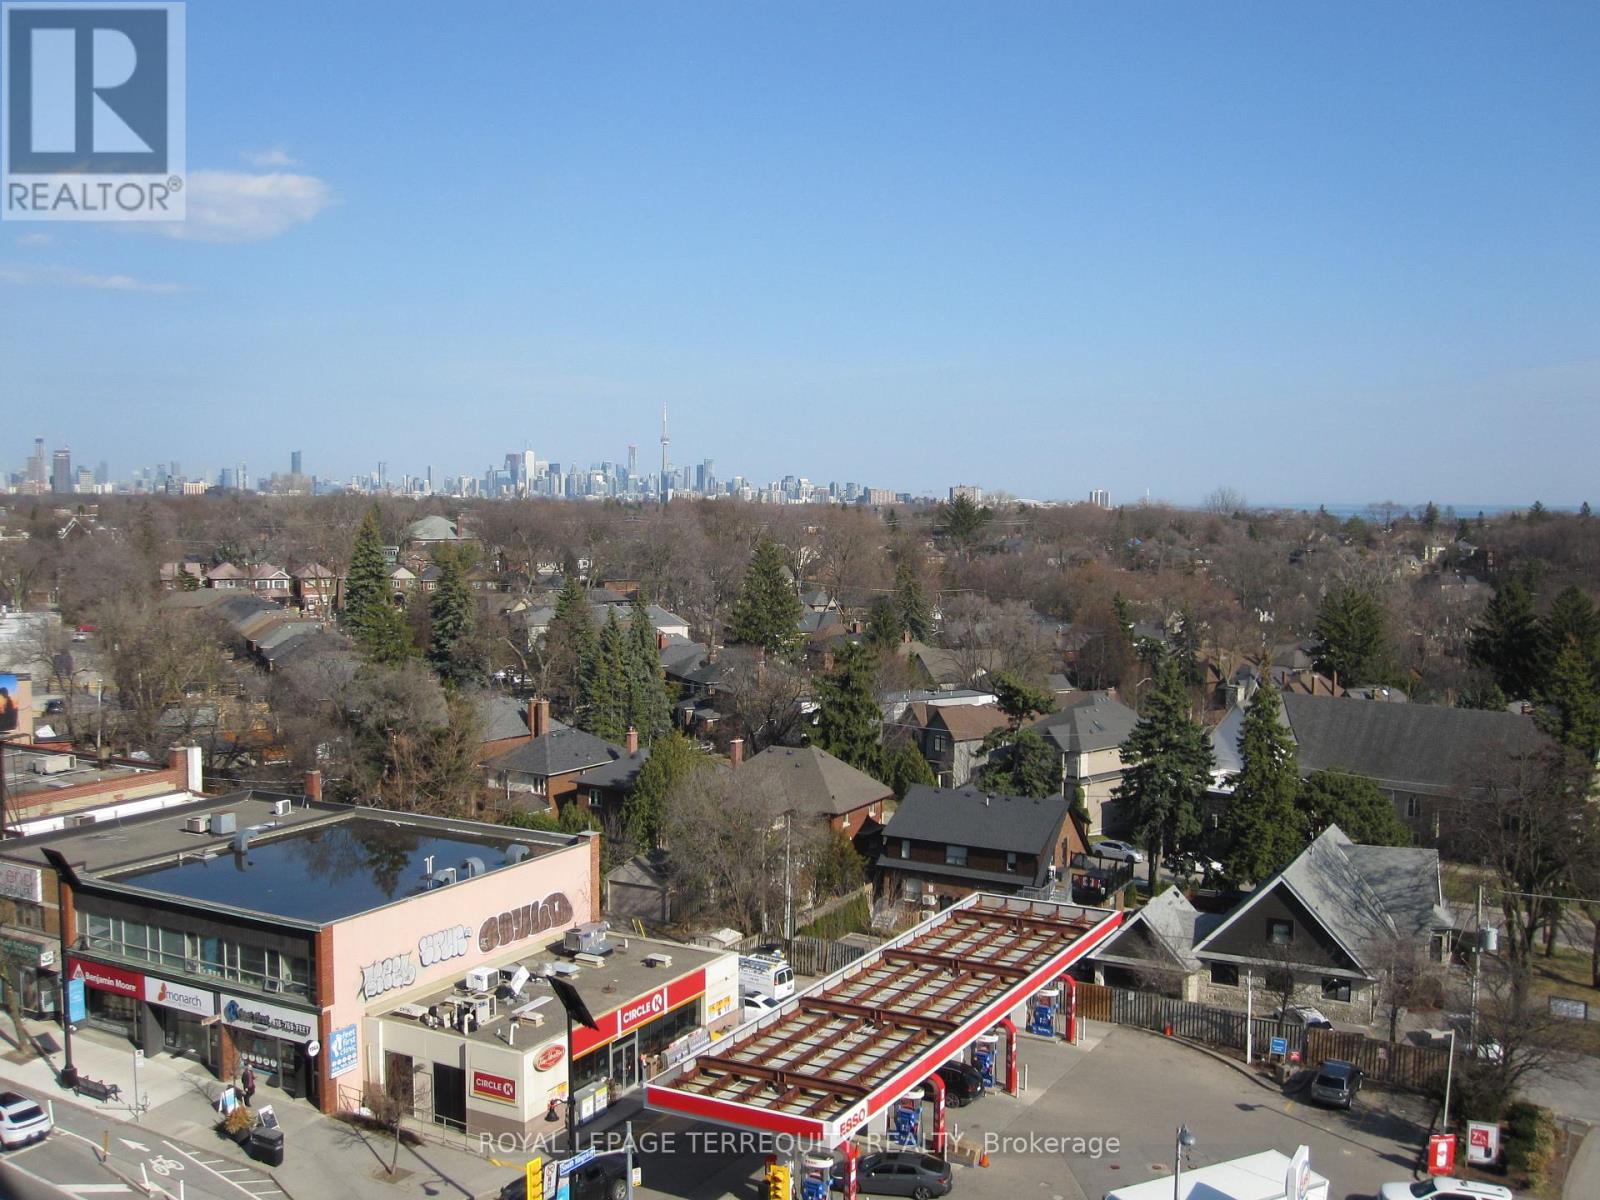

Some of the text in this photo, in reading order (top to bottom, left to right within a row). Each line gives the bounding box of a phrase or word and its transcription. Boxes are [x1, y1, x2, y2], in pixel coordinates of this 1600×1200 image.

[85, 971, 137, 992] Benjamin Moore
[166, 991, 202, 1007] monarch
[623, 993, 663, 1024] CIRCLE K
[475, 1078, 513, 1096] CIRCLE K
[840, 1108, 866, 1137] ESSO
